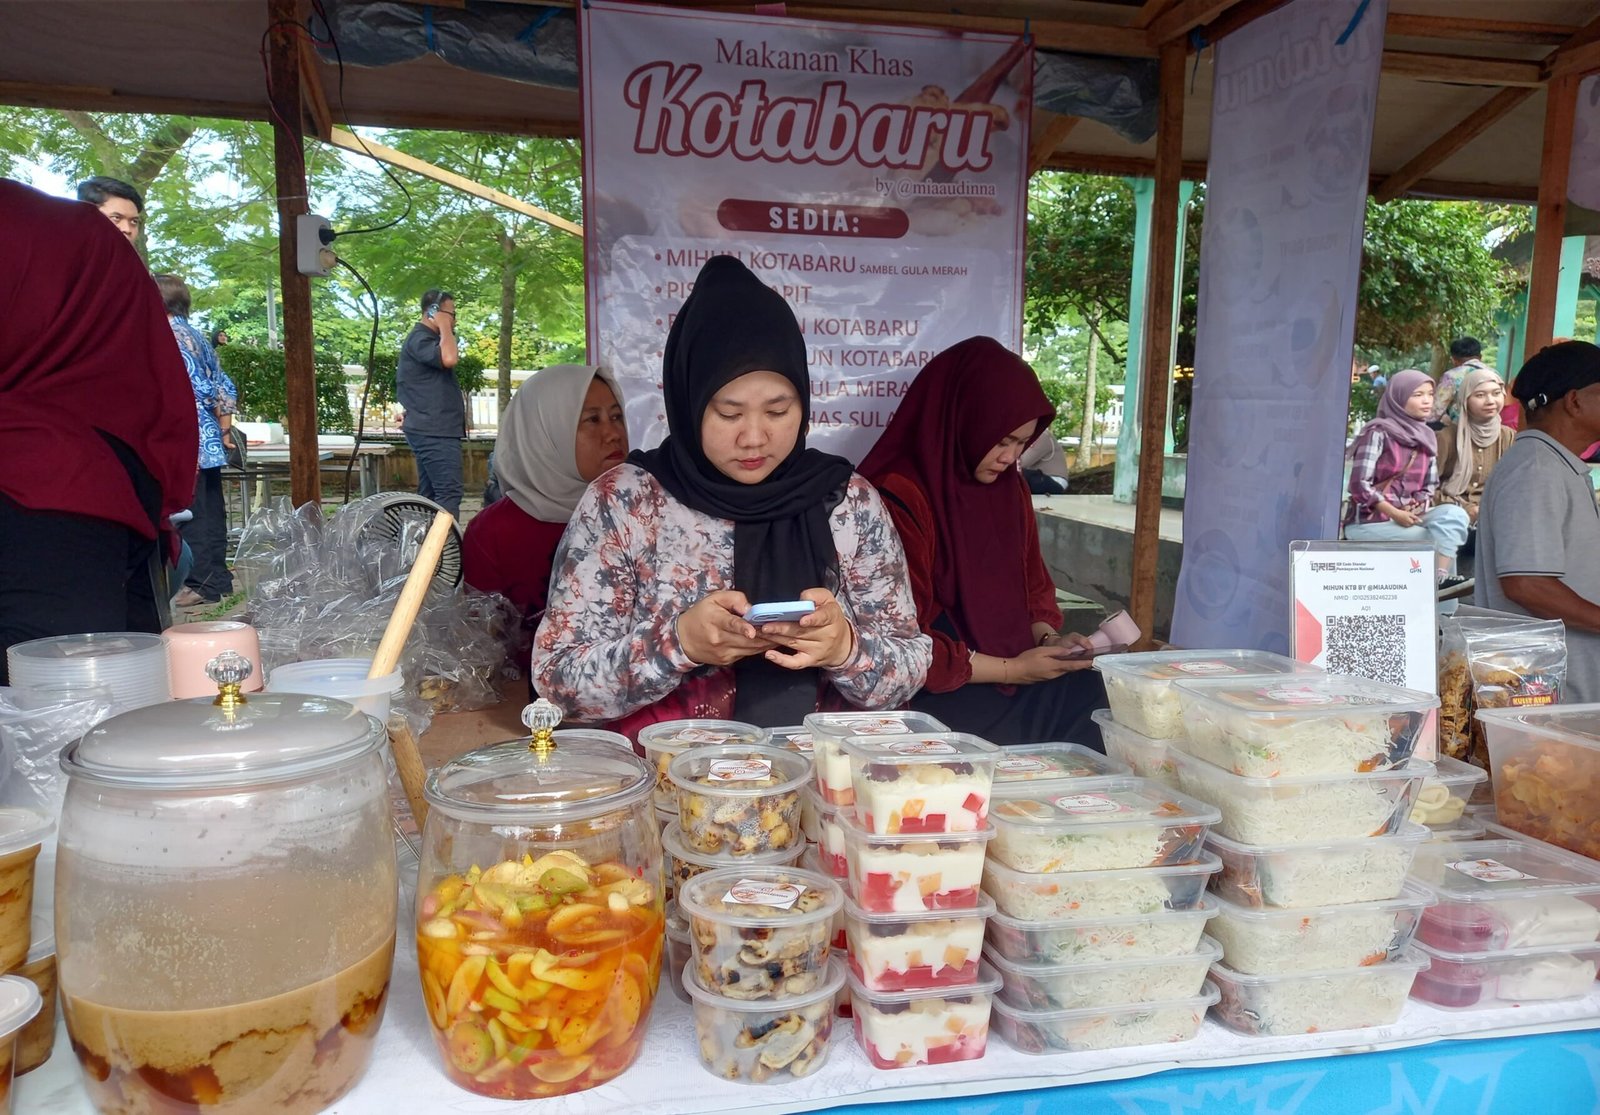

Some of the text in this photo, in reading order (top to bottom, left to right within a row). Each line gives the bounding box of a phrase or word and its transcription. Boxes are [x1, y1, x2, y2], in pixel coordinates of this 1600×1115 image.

[716, 38, 914, 77] Makanan Khas
[624, 61, 993, 172] Kotabaru
[875, 177, 996, 198] by @miaaudinna
[769, 206, 860, 233] SEDIA:
[750, 252, 856, 273] KOTABARU
[859, 264, 899, 275] SAMBEL
[901, 265, 929, 275] GULA
[932, 266, 968, 276] MERAH
[814, 318, 919, 337] KOTABARU
[811, 380, 908, 398] ULA MERA
